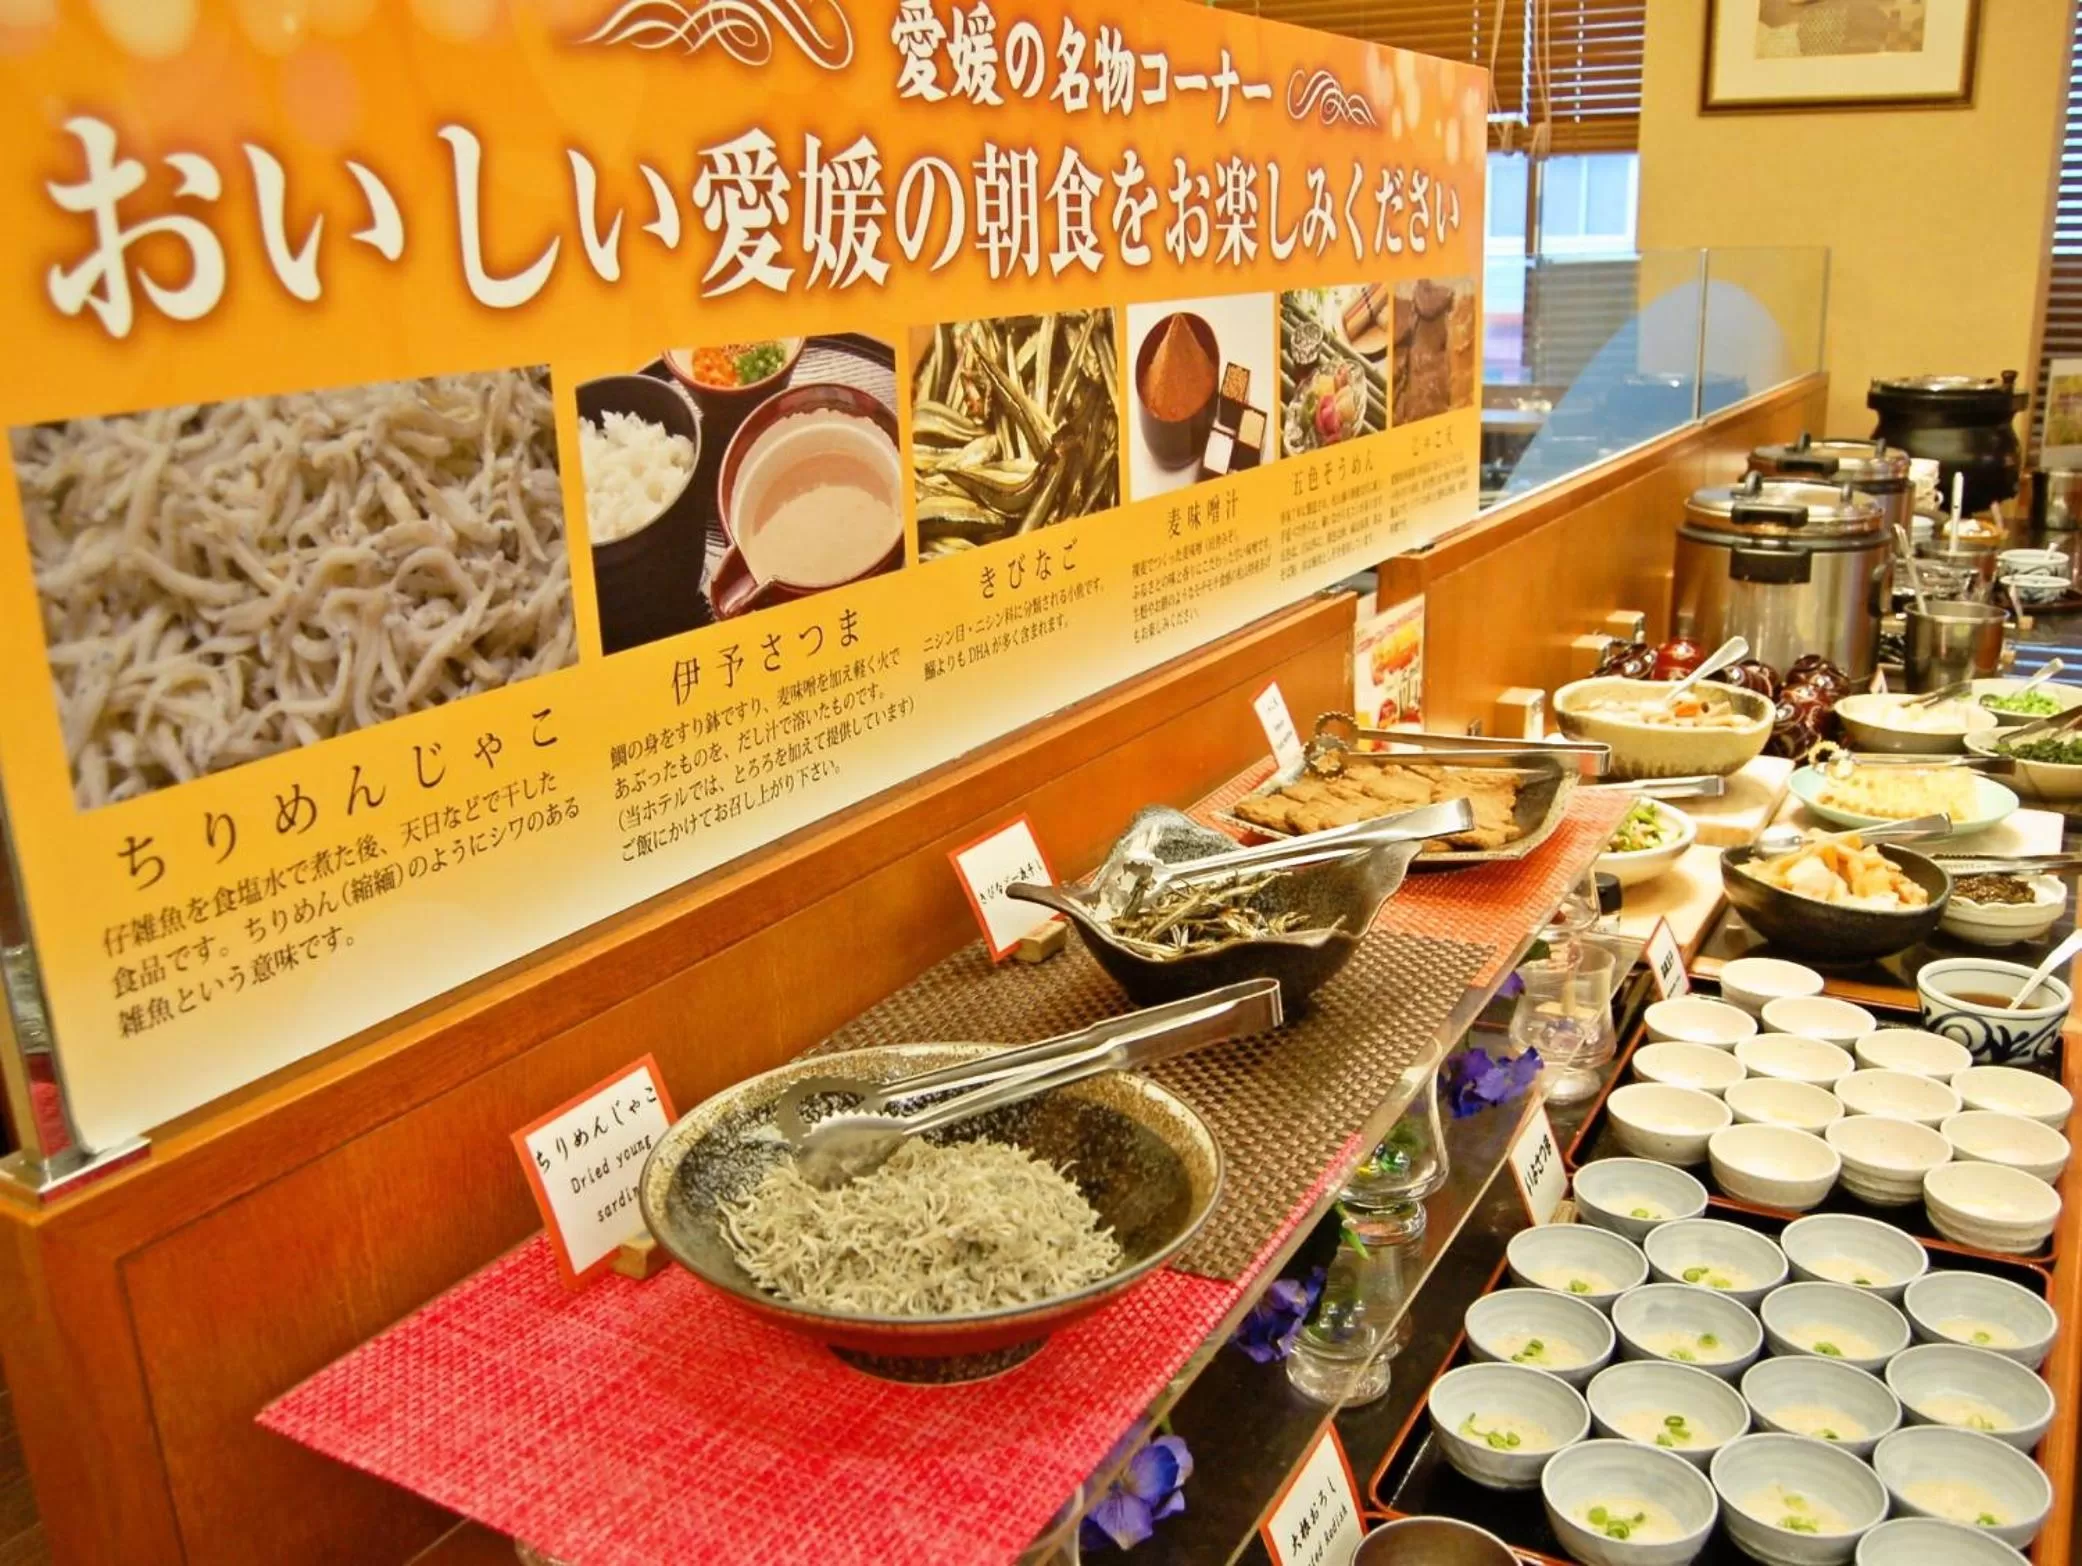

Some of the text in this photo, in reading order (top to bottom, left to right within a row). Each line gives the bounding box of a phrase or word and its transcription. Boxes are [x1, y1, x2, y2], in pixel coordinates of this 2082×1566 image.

[891, 0, 1273, 125] 愛媛の名物コーナー
[46, 116, 1461, 339] おいしい愛媛の朝食をお楽しみください
[1167, 488, 1239, 539] 麦味噌汁
[1291, 448, 1375, 496] 五色そうめん
[979, 535, 1078, 600] きびなご
[671, 608, 860, 707] 伊予さつま
[609, 647, 901, 770] 鯛の身をすり鉢ですり、麦味噌を加え軽く火で
[614, 683, 885, 801] あぶったものを、だし汁で溶いたものです。
[117, 707, 559, 891] ちりめんじゃこ
[621, 759, 841, 863] ご飯にかけてお召し上がり下さい。
[103, 770, 557, 960] 仔雑魚を食塩水で煮た後、天日などで干した
[118, 924, 356, 1040] 雑魚という意味です。
[536, 1085, 658, 1174] ちりめんじゃこ
[570, 1134, 653, 1195] Dried young
[597, 1184, 641, 1223] sardin
[1291, 1476, 1337, 1557] 大根おろし
